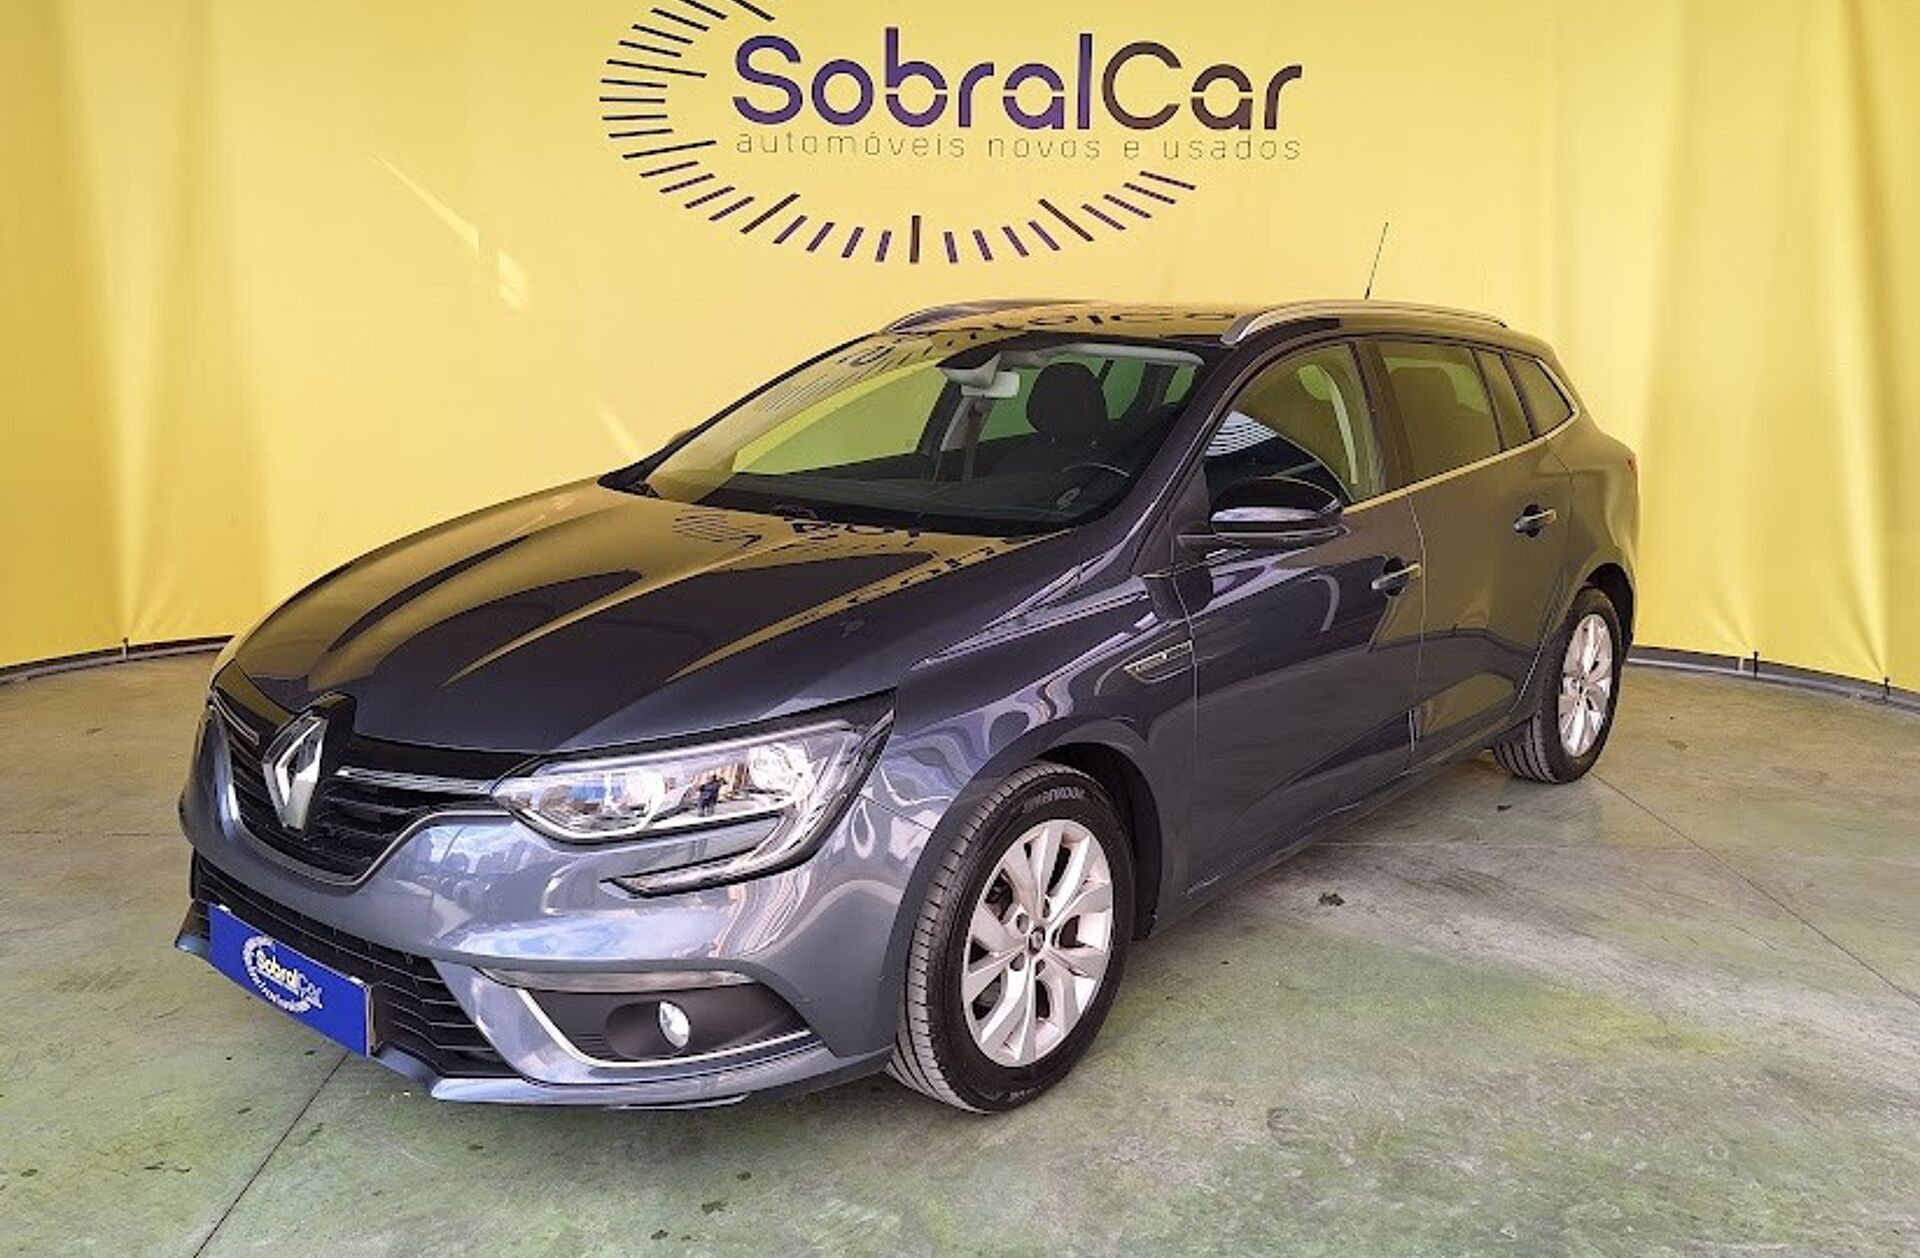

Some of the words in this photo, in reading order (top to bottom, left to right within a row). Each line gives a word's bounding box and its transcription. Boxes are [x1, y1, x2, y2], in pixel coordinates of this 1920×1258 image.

[732, 27, 1302, 129] SobralCar
[736, 131, 966, 158] automóveis
[987, 136, 1100, 159] novos
[1123, 140, 1140, 159] e
[1163, 134, 1301, 161] usados
